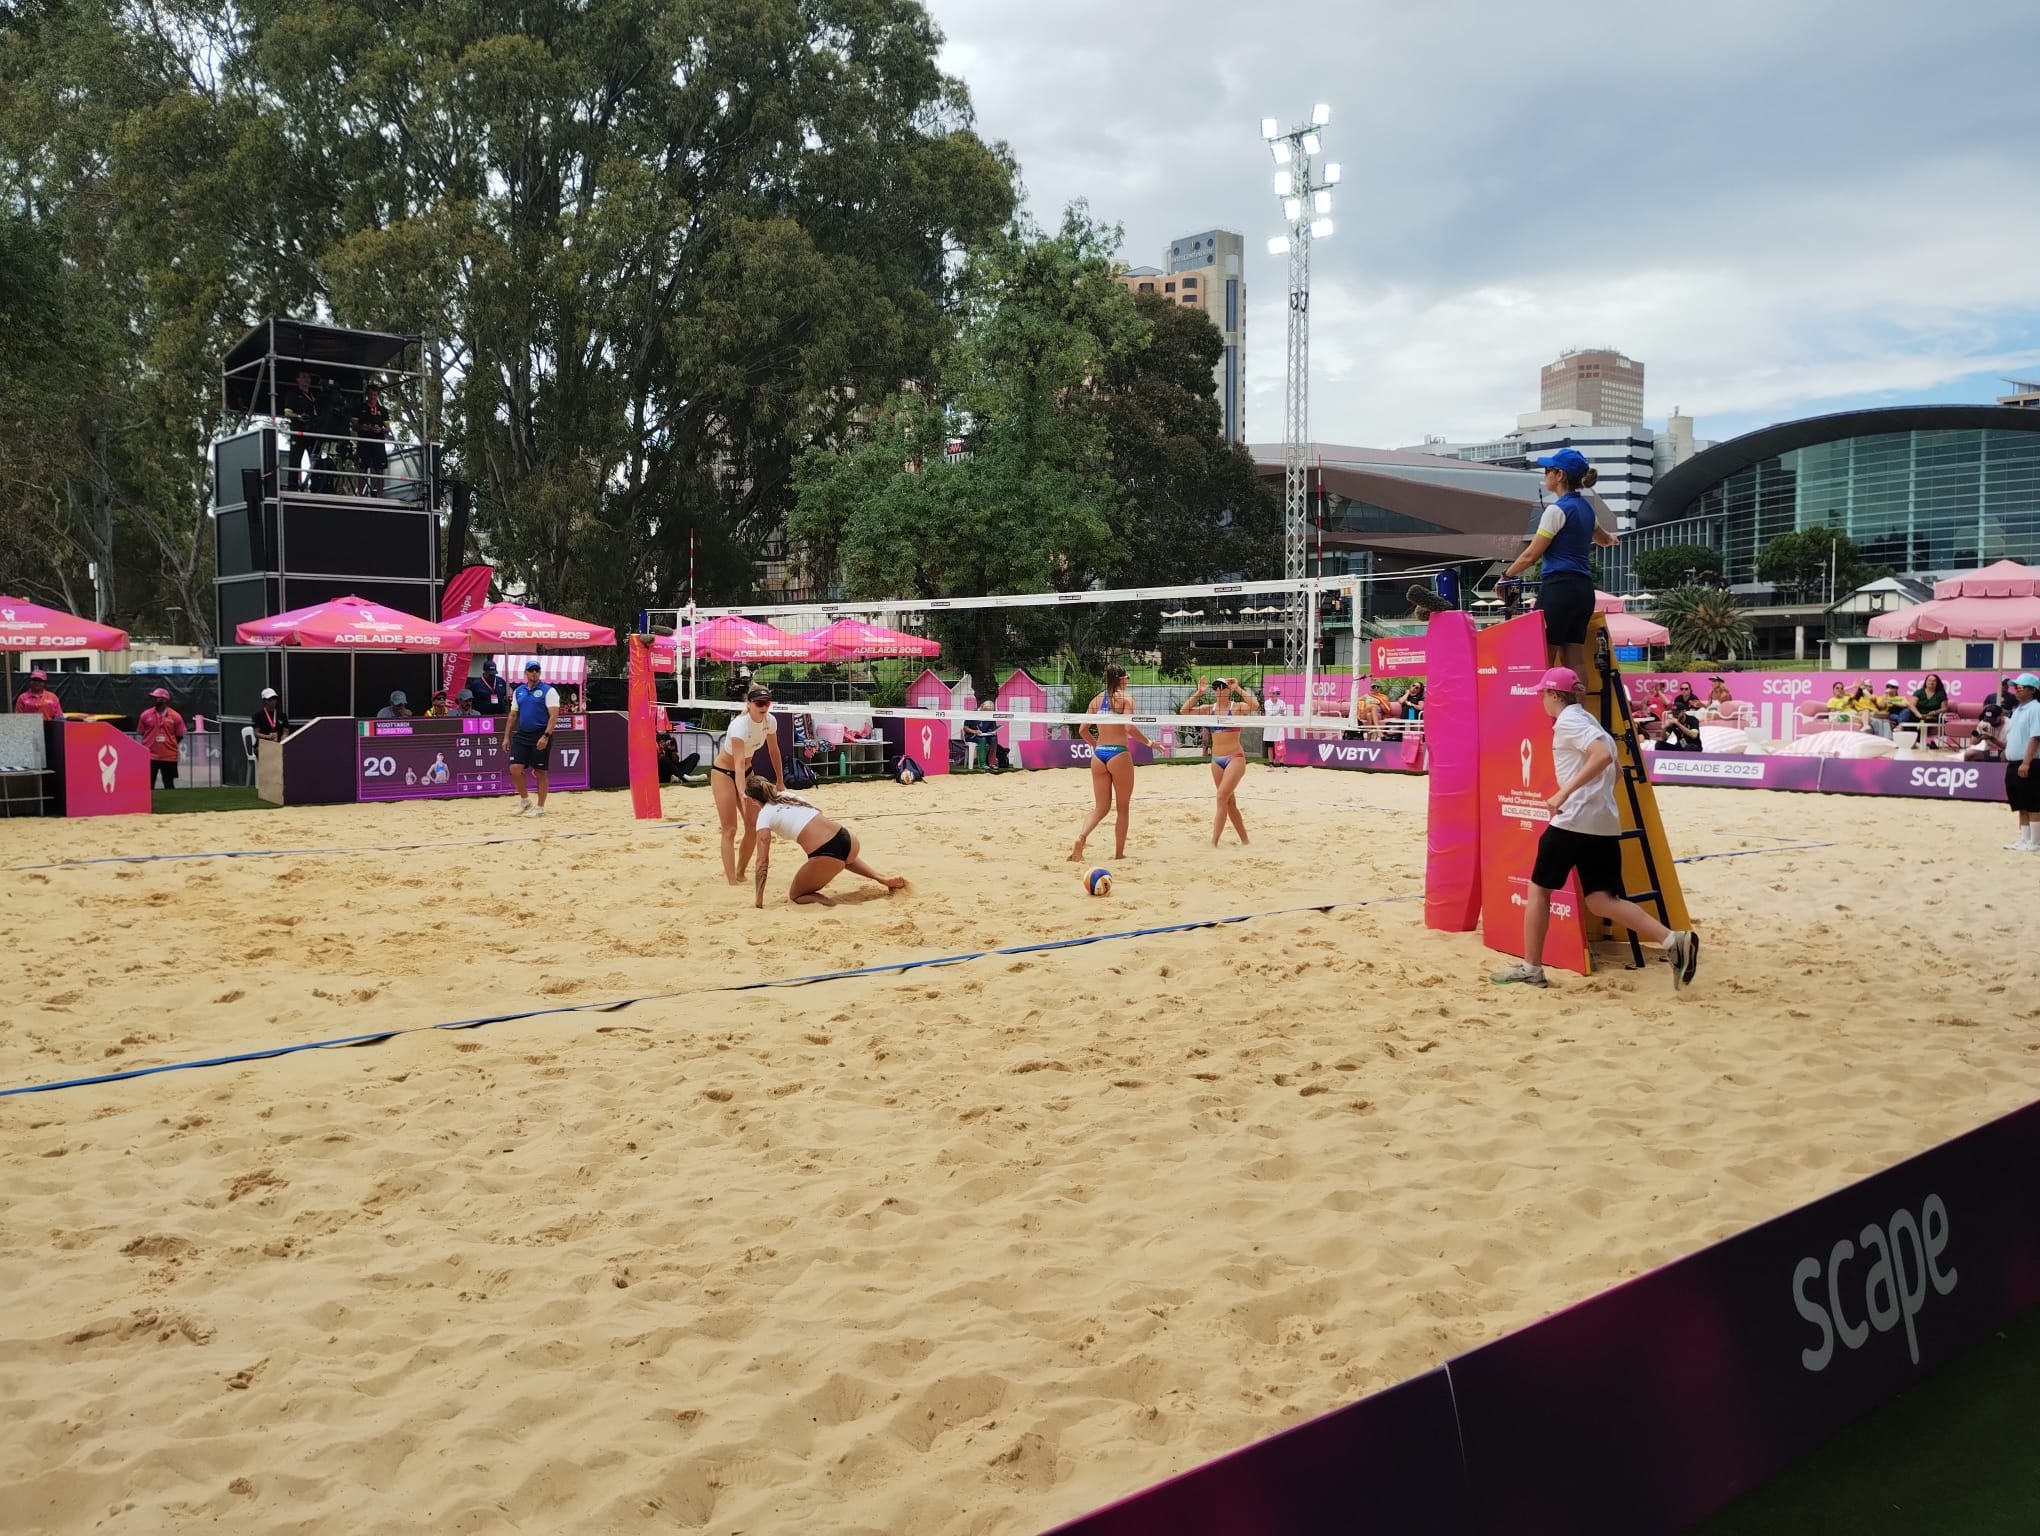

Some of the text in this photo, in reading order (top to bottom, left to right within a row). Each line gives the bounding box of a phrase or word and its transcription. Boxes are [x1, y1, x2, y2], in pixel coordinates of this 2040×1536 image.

[334, 634, 441, 645] ADELAIDE 2025
[499, 630, 591, 640] ADELAIDE 2025
[40, 636, 88, 646] 2025
[732, 649, 783, 658] ADELAIDE
[853, 646, 898, 654] ADELAIDE
[1312, 681, 1336, 701] cape
[1762, 679, 1812, 700] scape
[1906, 679, 1962, 697] scpe
[468, 720, 474, 731] 1
[482, 720, 491, 731] 0
[460, 738, 470, 746] 21
[488, 737, 498, 745] 18
[458, 749, 471, 757] 20
[488, 748, 498, 756] 17
[1070, 743, 1094, 759] sca
[1336, 746, 1381, 762] VBTV
[560, 749, 580, 767] 17
[363, 756, 397, 777] 20
[1659, 762, 1760, 775] ADELAIDE 2025
[1910, 766, 1979, 796] scape
[1792, 1193, 1958, 1371] scape
